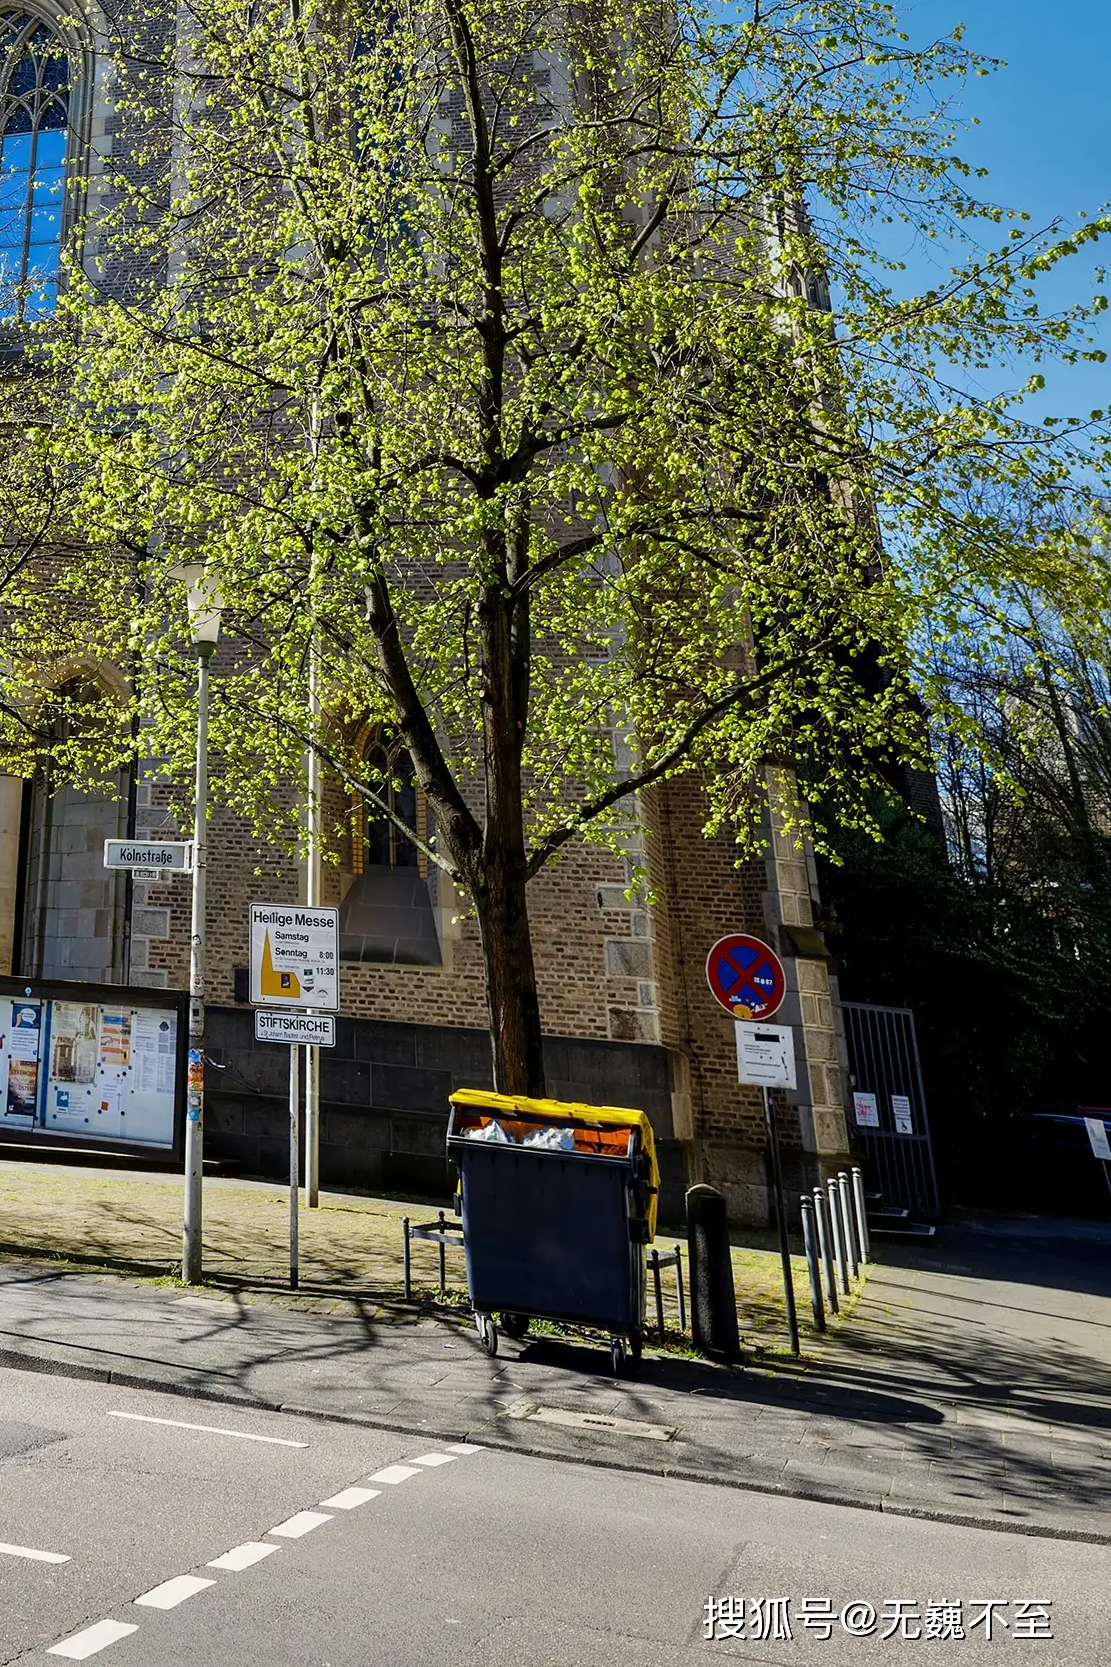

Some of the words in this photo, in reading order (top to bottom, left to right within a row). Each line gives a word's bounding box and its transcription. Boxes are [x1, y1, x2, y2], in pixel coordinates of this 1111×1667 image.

[120, 847, 173, 865] Kölnstraße
[253, 910, 293, 927] Heilige
[295, 913, 334, 928] Messe
[275, 930, 309, 943] Samstag
[275, 946, 308, 959] Sonntag
[319, 950, 334, 960] 8:00
[316, 967, 335, 976] 11:30
[259, 1016, 330, 1033] STIFTSKIRCHE
